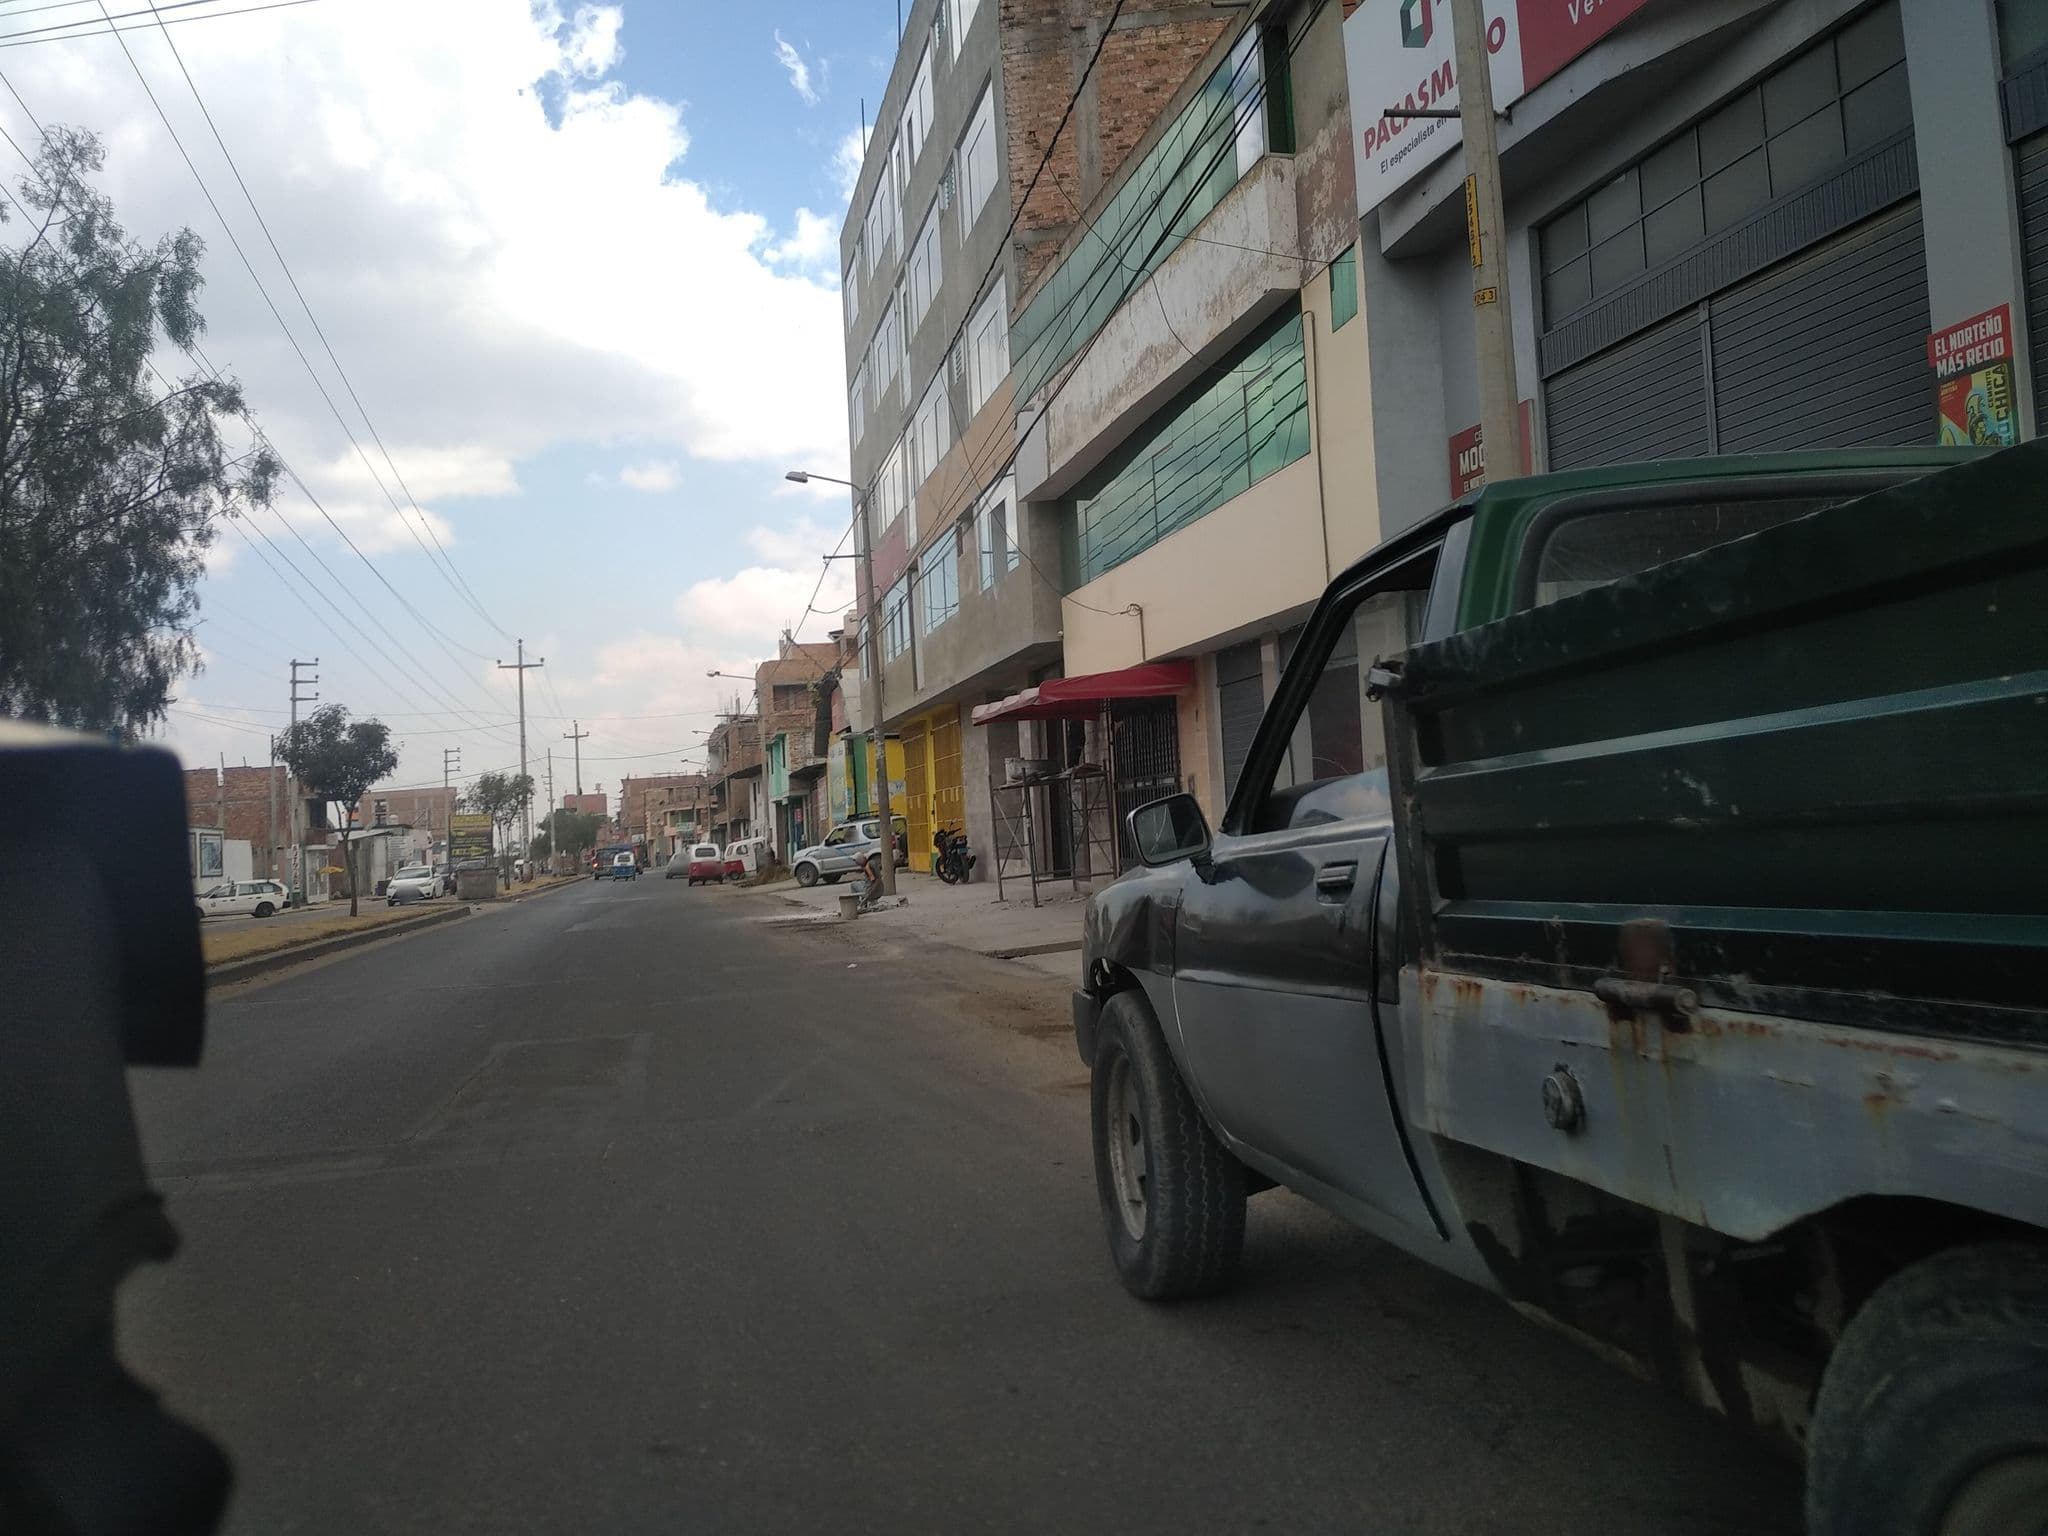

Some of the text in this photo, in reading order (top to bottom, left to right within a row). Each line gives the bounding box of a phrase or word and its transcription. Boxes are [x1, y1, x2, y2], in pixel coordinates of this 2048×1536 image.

[1568, 0, 1604, 25] Ve
[1364, 16, 1506, 160] PACASMO
[1380, 158, 1389, 175] El
[1390, 125, 1435, 167] especialista
[1934, 315, 2003, 358] EL NORTEÑO
[1936, 336, 2006, 379] MÁS RECIO
[1459, 445, 1486, 477] MOC
